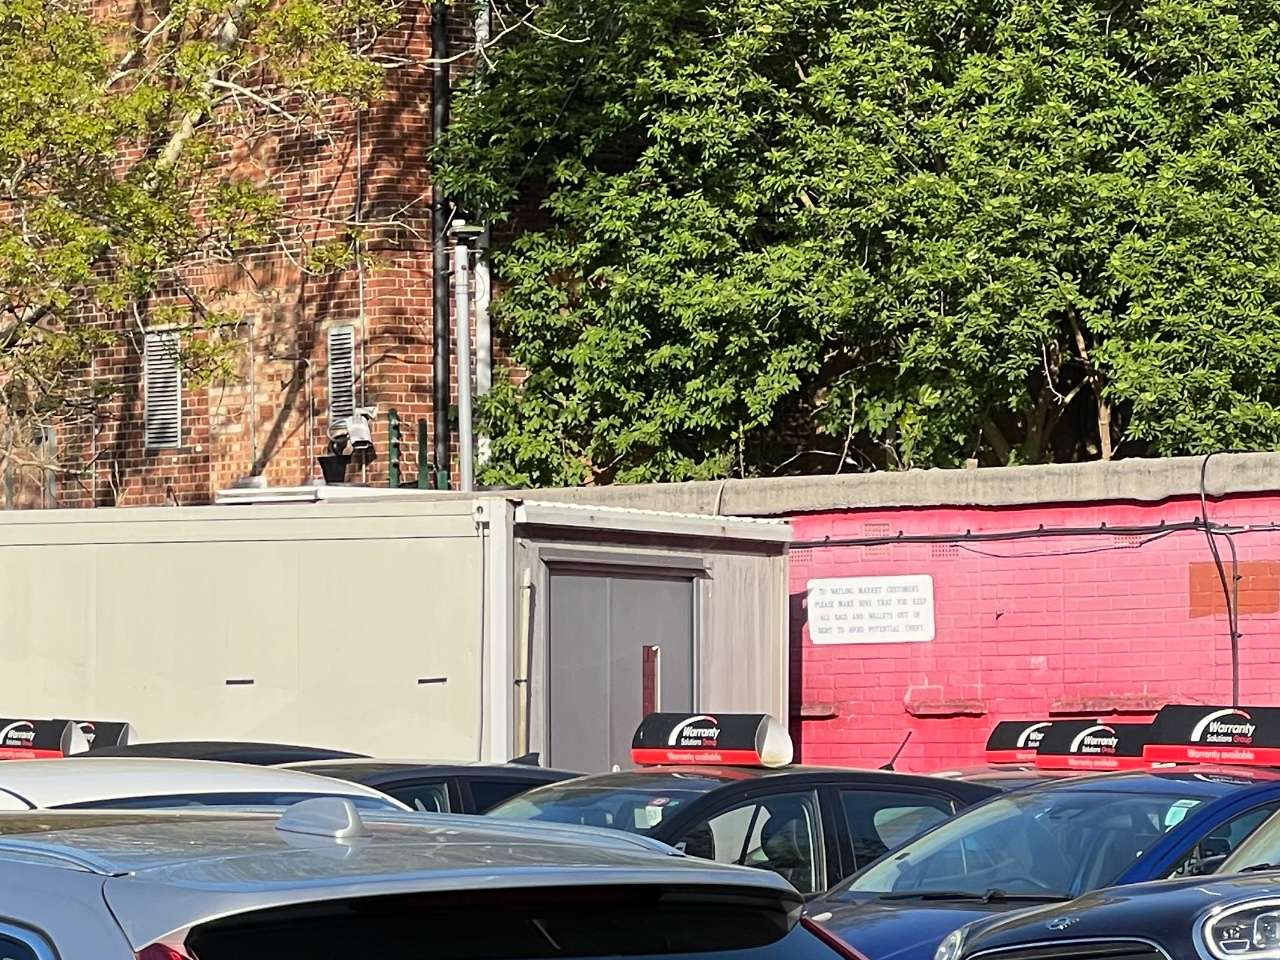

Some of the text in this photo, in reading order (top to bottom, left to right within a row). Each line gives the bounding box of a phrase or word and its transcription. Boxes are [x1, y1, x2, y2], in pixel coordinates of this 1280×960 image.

[683, 726, 720, 740] Warranty
[1210, 721, 1255, 737] Warranty
[681, 738, 702, 746] Solutions
[1083, 735, 1118, 748] Warranty
[1206, 734, 1232, 743] Solutions
